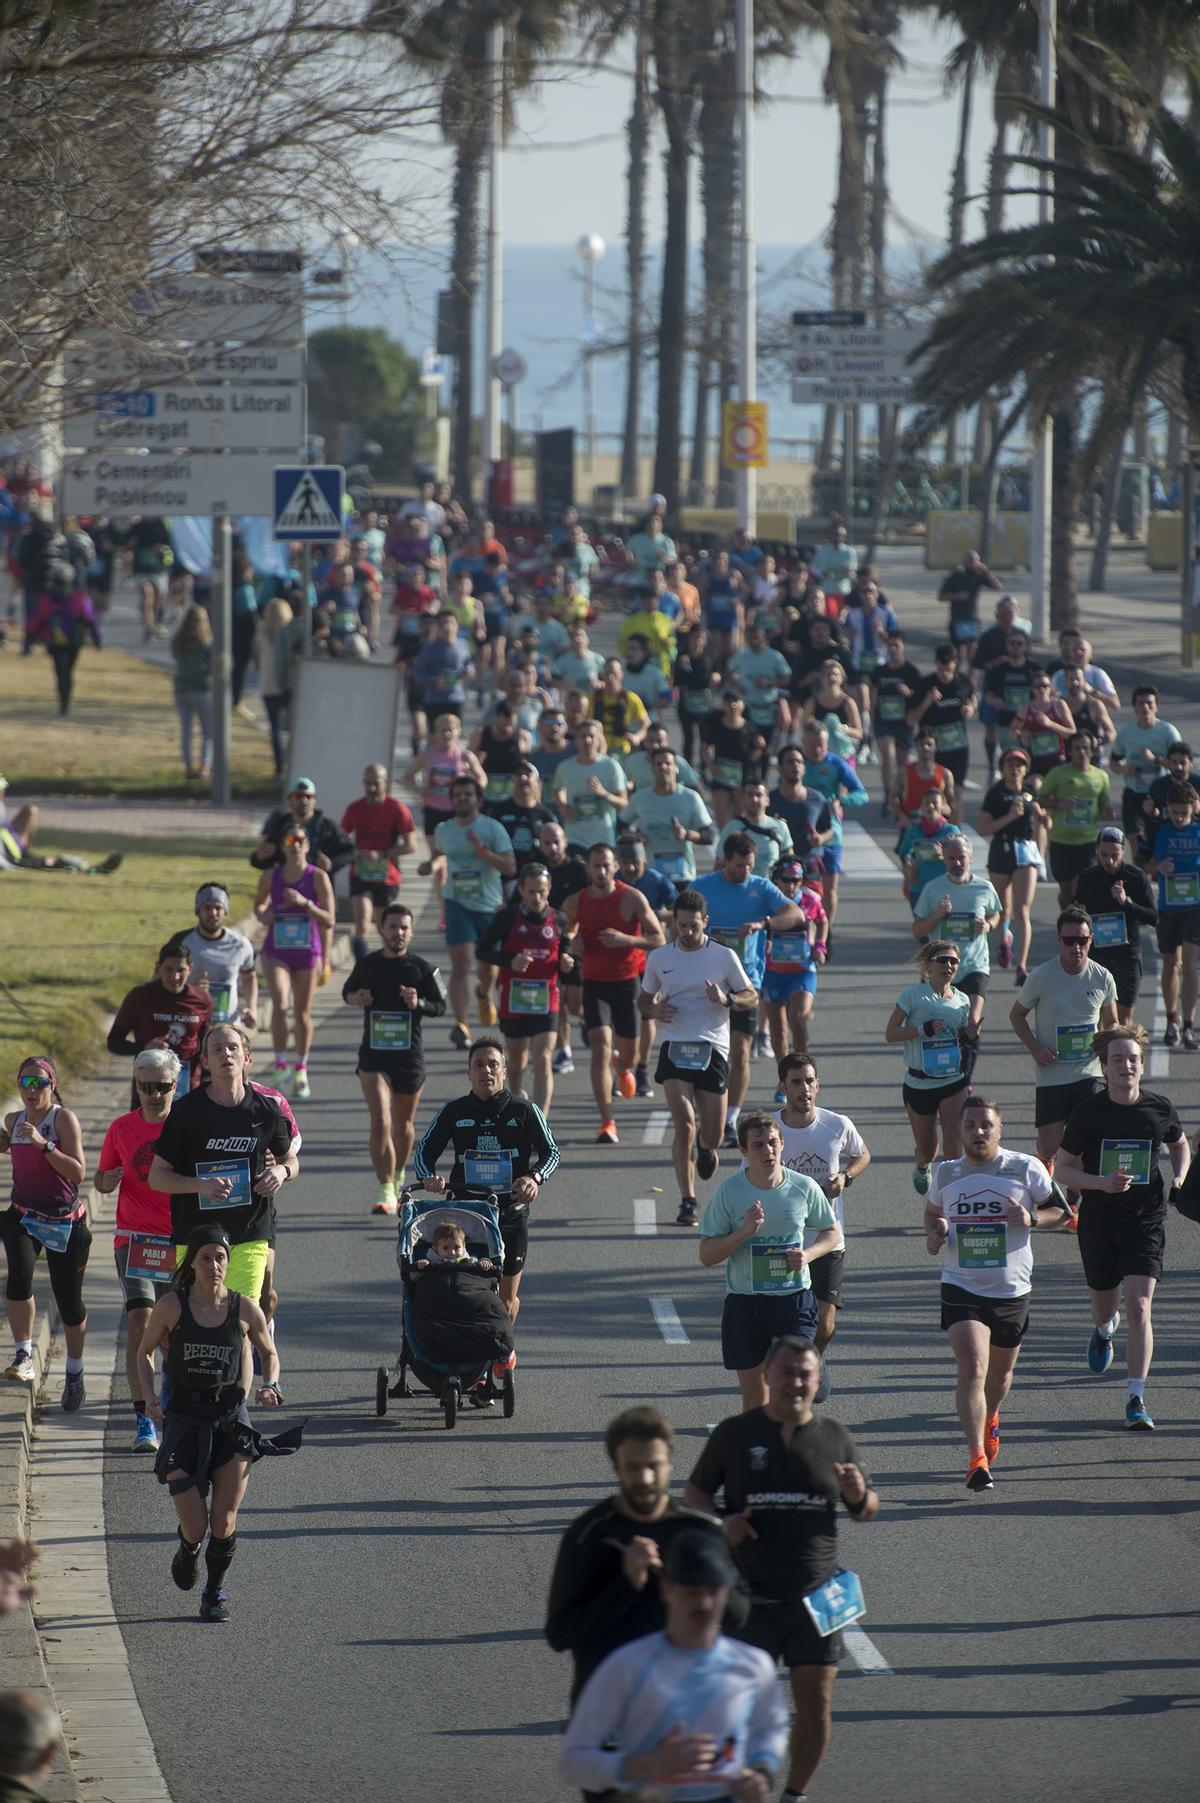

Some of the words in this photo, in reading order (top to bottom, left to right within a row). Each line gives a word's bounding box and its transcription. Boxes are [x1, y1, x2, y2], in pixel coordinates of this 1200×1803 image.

[216, 352, 278, 373] Espriu
[163, 392, 225, 412] Ronda
[231, 392, 291, 412] Litoral
[96, 460, 192, 481] Cementiri
[95, 486, 188, 506] Poblenou
[957, 1201, 1002, 1215] DPS
[962, 1237, 999, 1248] GIUSEPPE
[142, 1248, 167, 1260] PABLO
[183, 1342, 235, 1365] REEBOK
